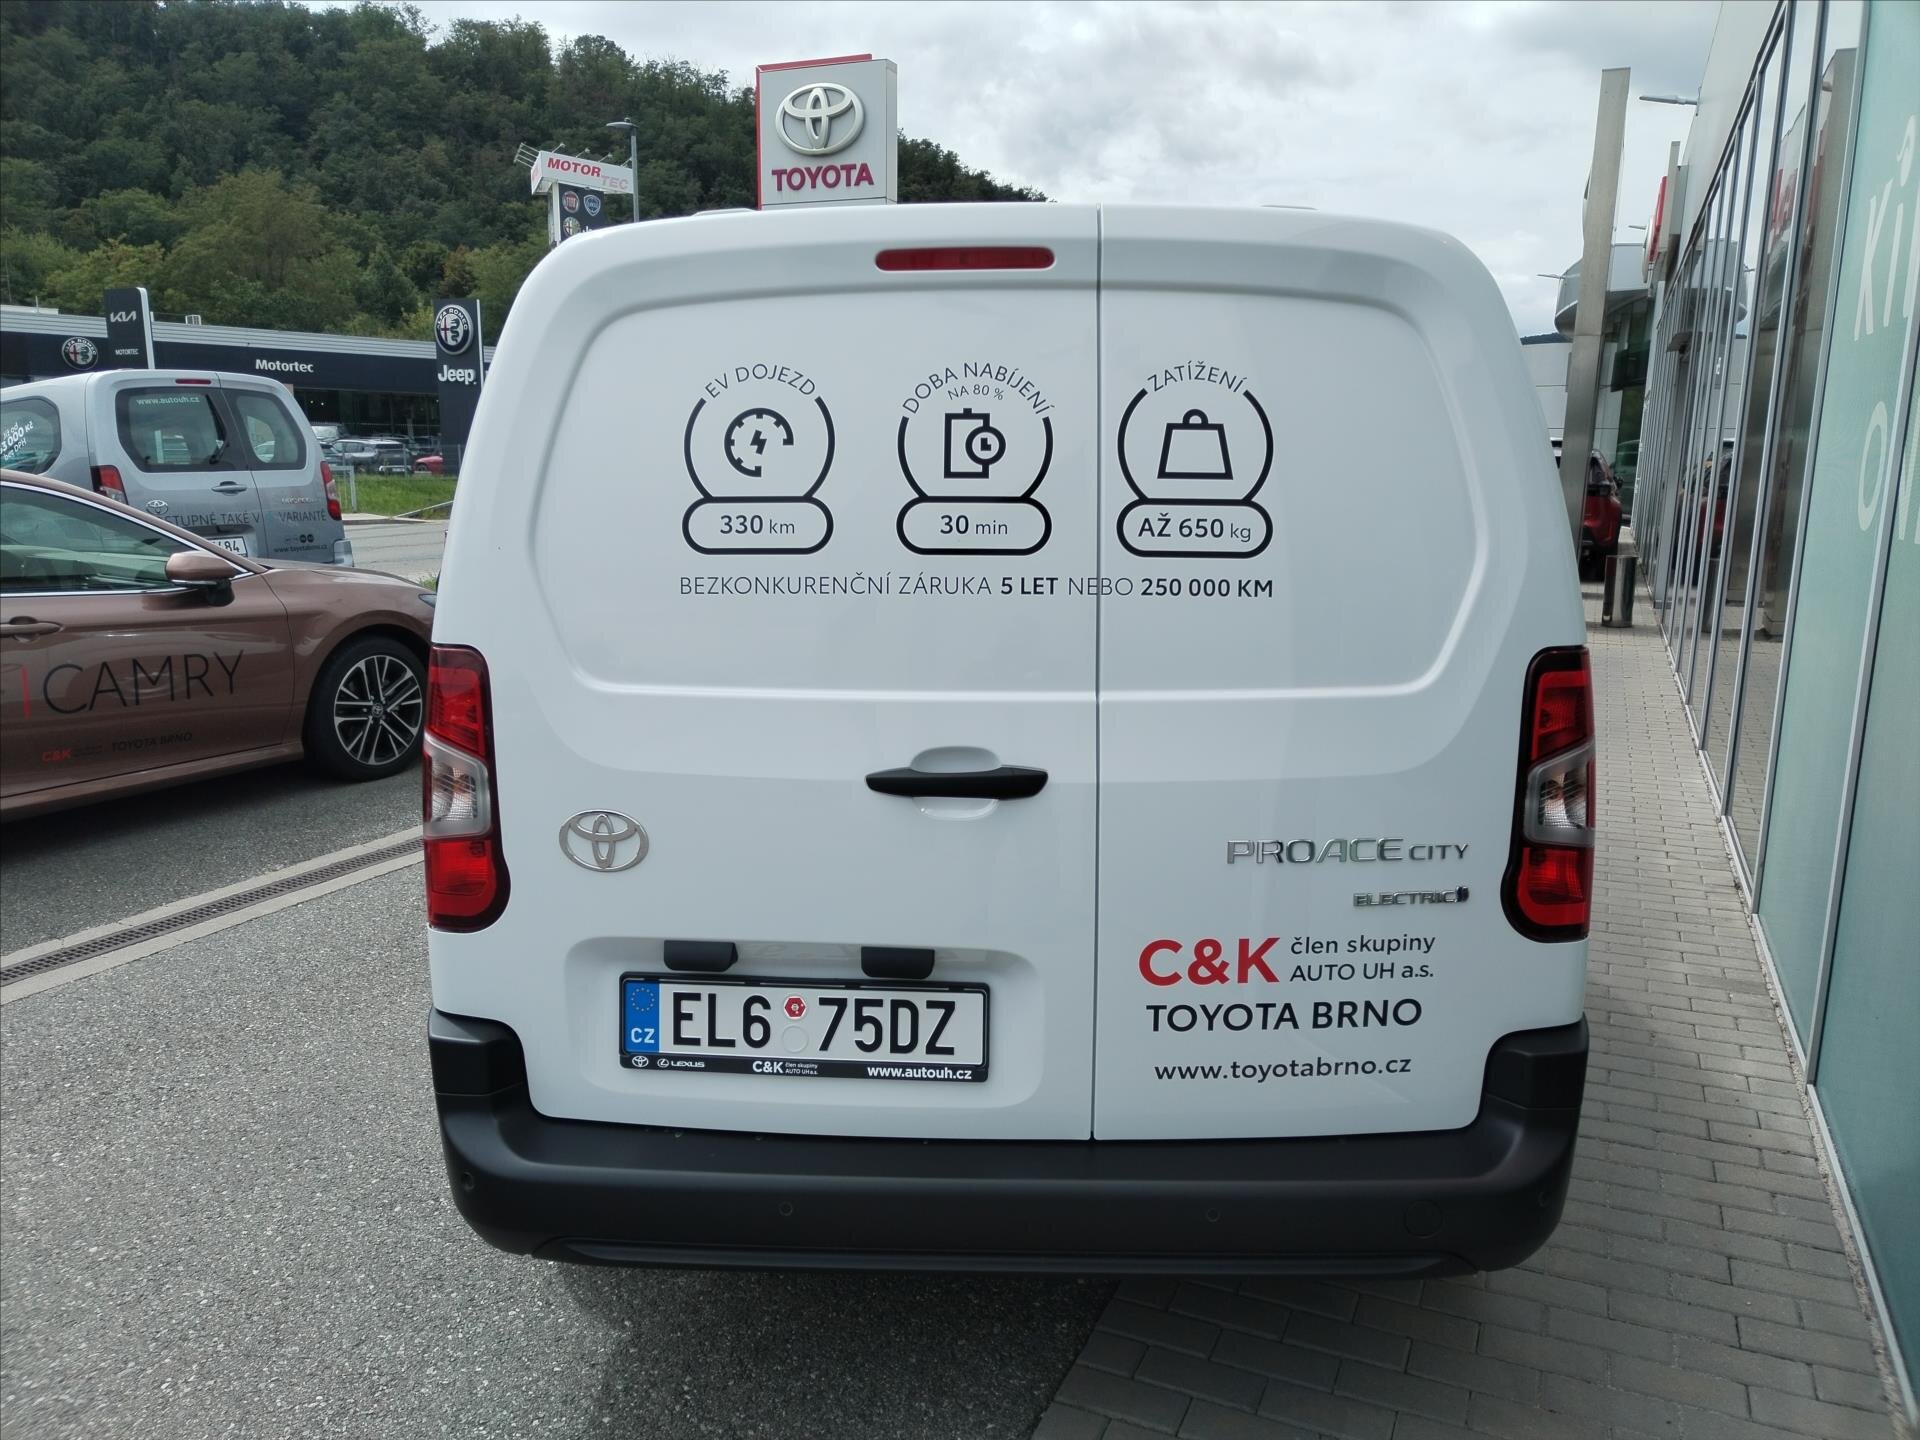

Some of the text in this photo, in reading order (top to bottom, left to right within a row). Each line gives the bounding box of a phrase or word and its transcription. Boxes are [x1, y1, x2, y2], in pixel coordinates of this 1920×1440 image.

[771, 162, 874, 192] TOYOTA
[449, 308, 468, 330] ROMEO
[115, 348, 139, 356] MOTORTEC
[255, 358, 314, 373] Motortec
[437, 364, 475, 385] Jeep
[1147, 360, 1248, 392] ZATÍŽENÍ
[705, 363, 816, 398] EV DOJEZD
[902, 362, 1055, 414] DOBA NABÍJENÍ
[948, 384, 1003, 400] NA 80 %
[252, 512, 260, 523] V
[720, 515, 795, 534] 330 km
[940, 515, 1008, 535] 30 min
[1137, 512, 1251, 542] AŽ 650 kg
[680, 571, 1273, 598] BEZKONKURENČNÍ ZÁRUKA 5 LET NEBO 250 000 KM
[43, 649, 244, 714] CAMRY
[111, 739, 157, 751] TOYOTA
[1226, 838, 1470, 864] PROACE CITY
[1353, 889, 1458, 907] ELECTRIC
[1290, 934, 1436, 955] člen skupiny
[1138, 937, 1280, 986] C&K
[1289, 962, 1434, 983] AUTO UH a.s.
[672, 991, 957, 1056] EL6 75DZ
[1146, 998, 1422, 1032] TOYOTA BRNO
[630, 1027, 655, 1044] CZ
[671, 1060, 705, 1068] LEXUS
[752, 1060, 784, 1074] C&K
[867, 1066, 972, 1080] www.autouh.cz
[1154, 1057, 1411, 1083] www.toyotabrno.cz
